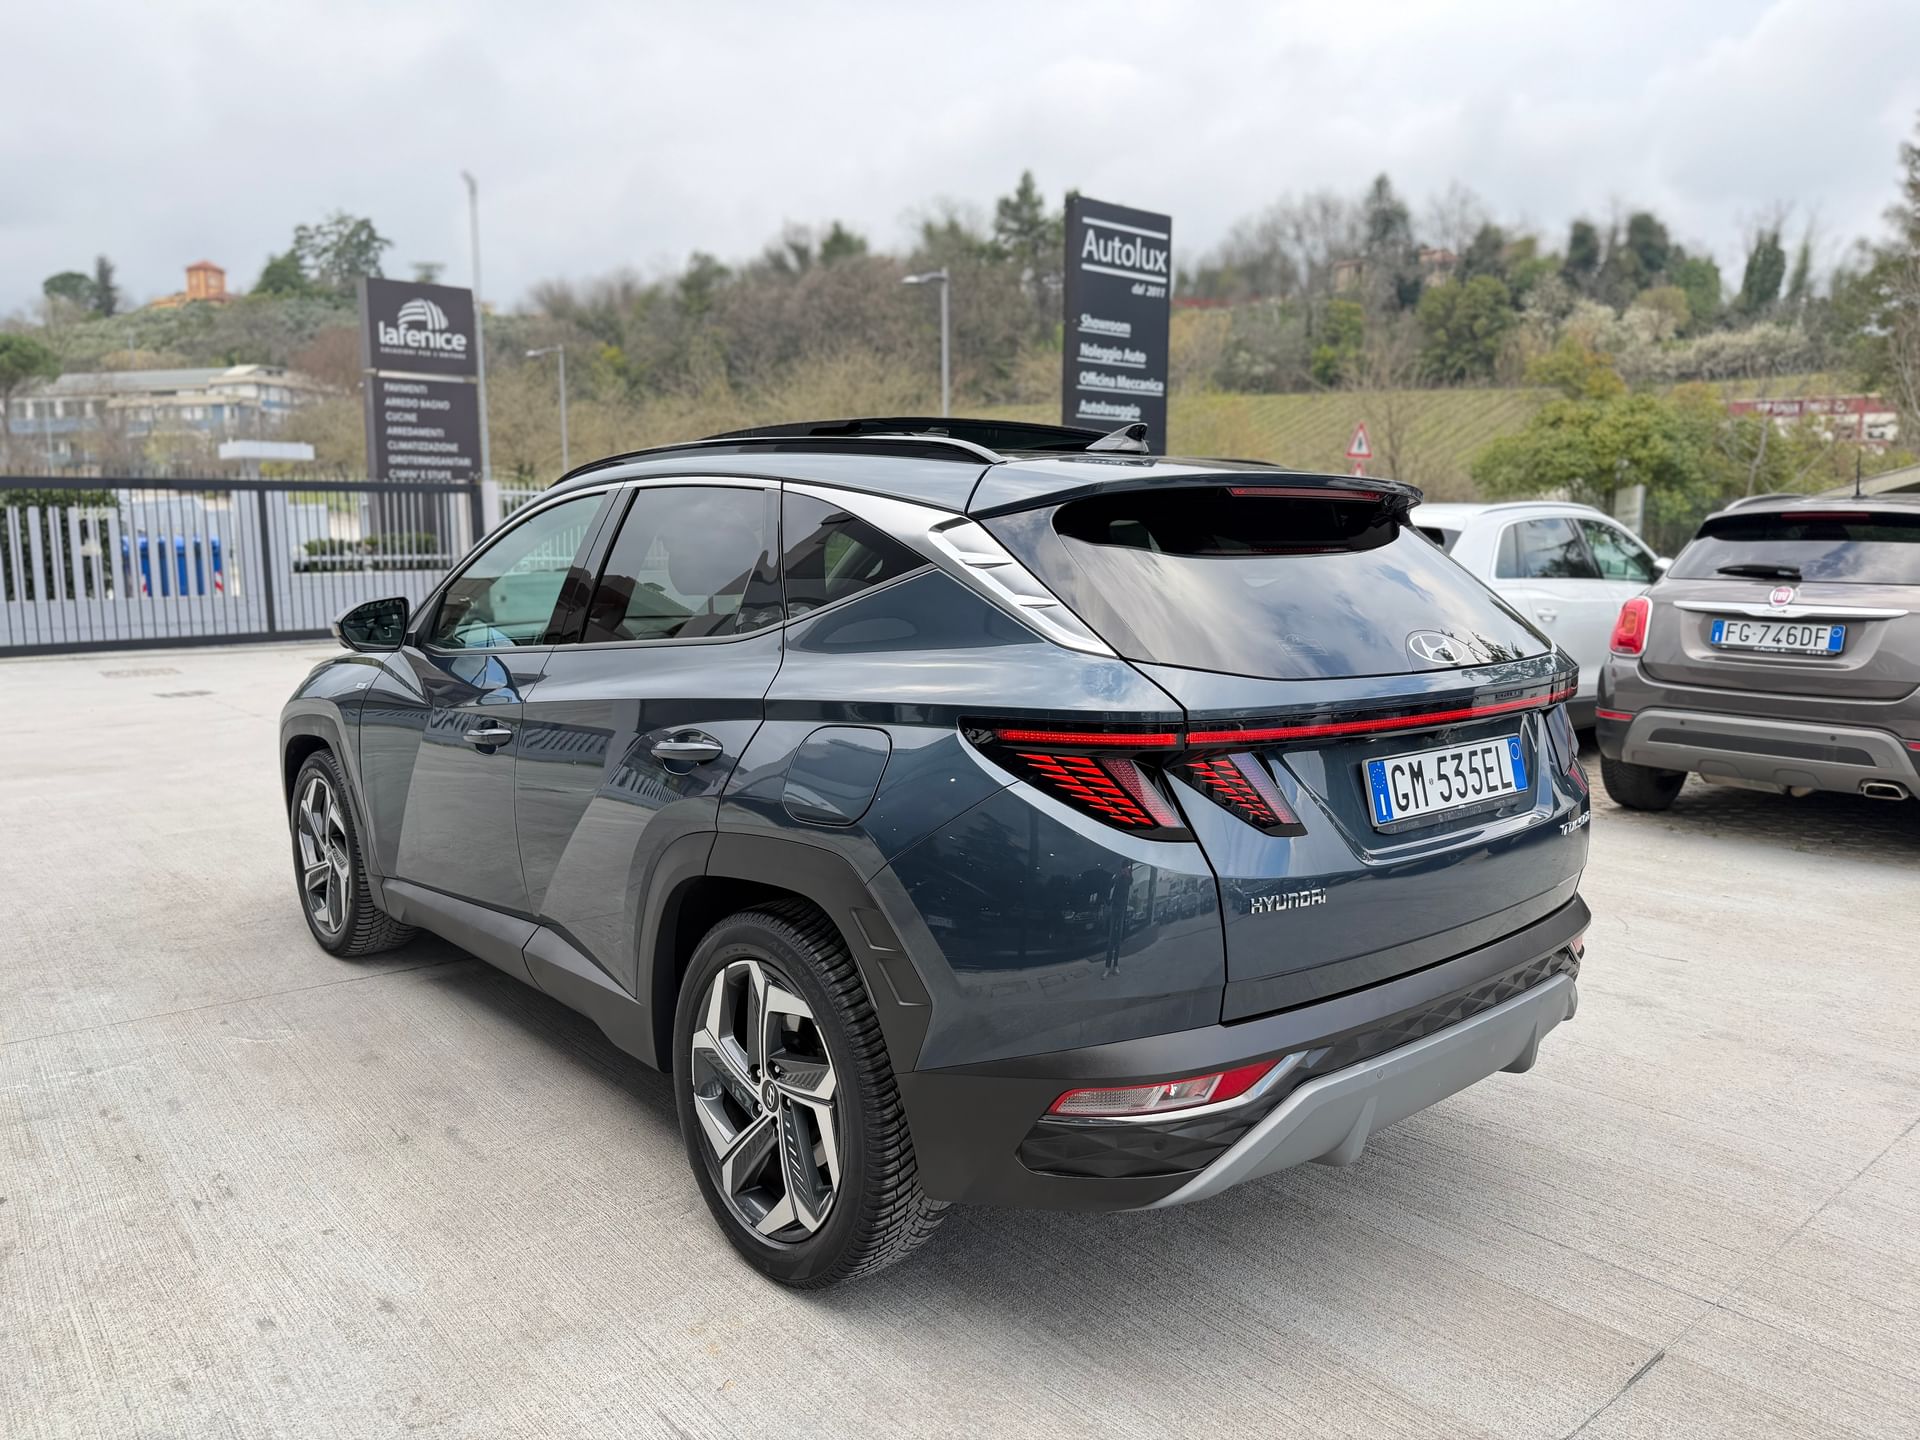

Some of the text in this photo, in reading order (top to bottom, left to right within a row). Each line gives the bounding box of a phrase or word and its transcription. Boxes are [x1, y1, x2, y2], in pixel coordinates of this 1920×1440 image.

[1081, 228, 1168, 273] Autolux
[1080, 313, 1131, 333] Showroom
[378, 320, 467, 351] lafenice
[1080, 342, 1147, 364] Noleggio Auto
[1080, 371, 1164, 392] Officina Meccanica
[384, 398, 451, 411] ARREDO BAGNO
[385, 411, 418, 423] CUCINE
[386, 426, 445, 438] ARREDAMENTI
[387, 440, 459, 453] CLIMATIZZAZIONE
[388, 454, 472, 467] IDROTERMOSANITARI
[1758, 624, 1828, 647] 746DF
[1391, 745, 1513, 812] GM 535EL
[1250, 887, 1327, 915] HYUNDAI
